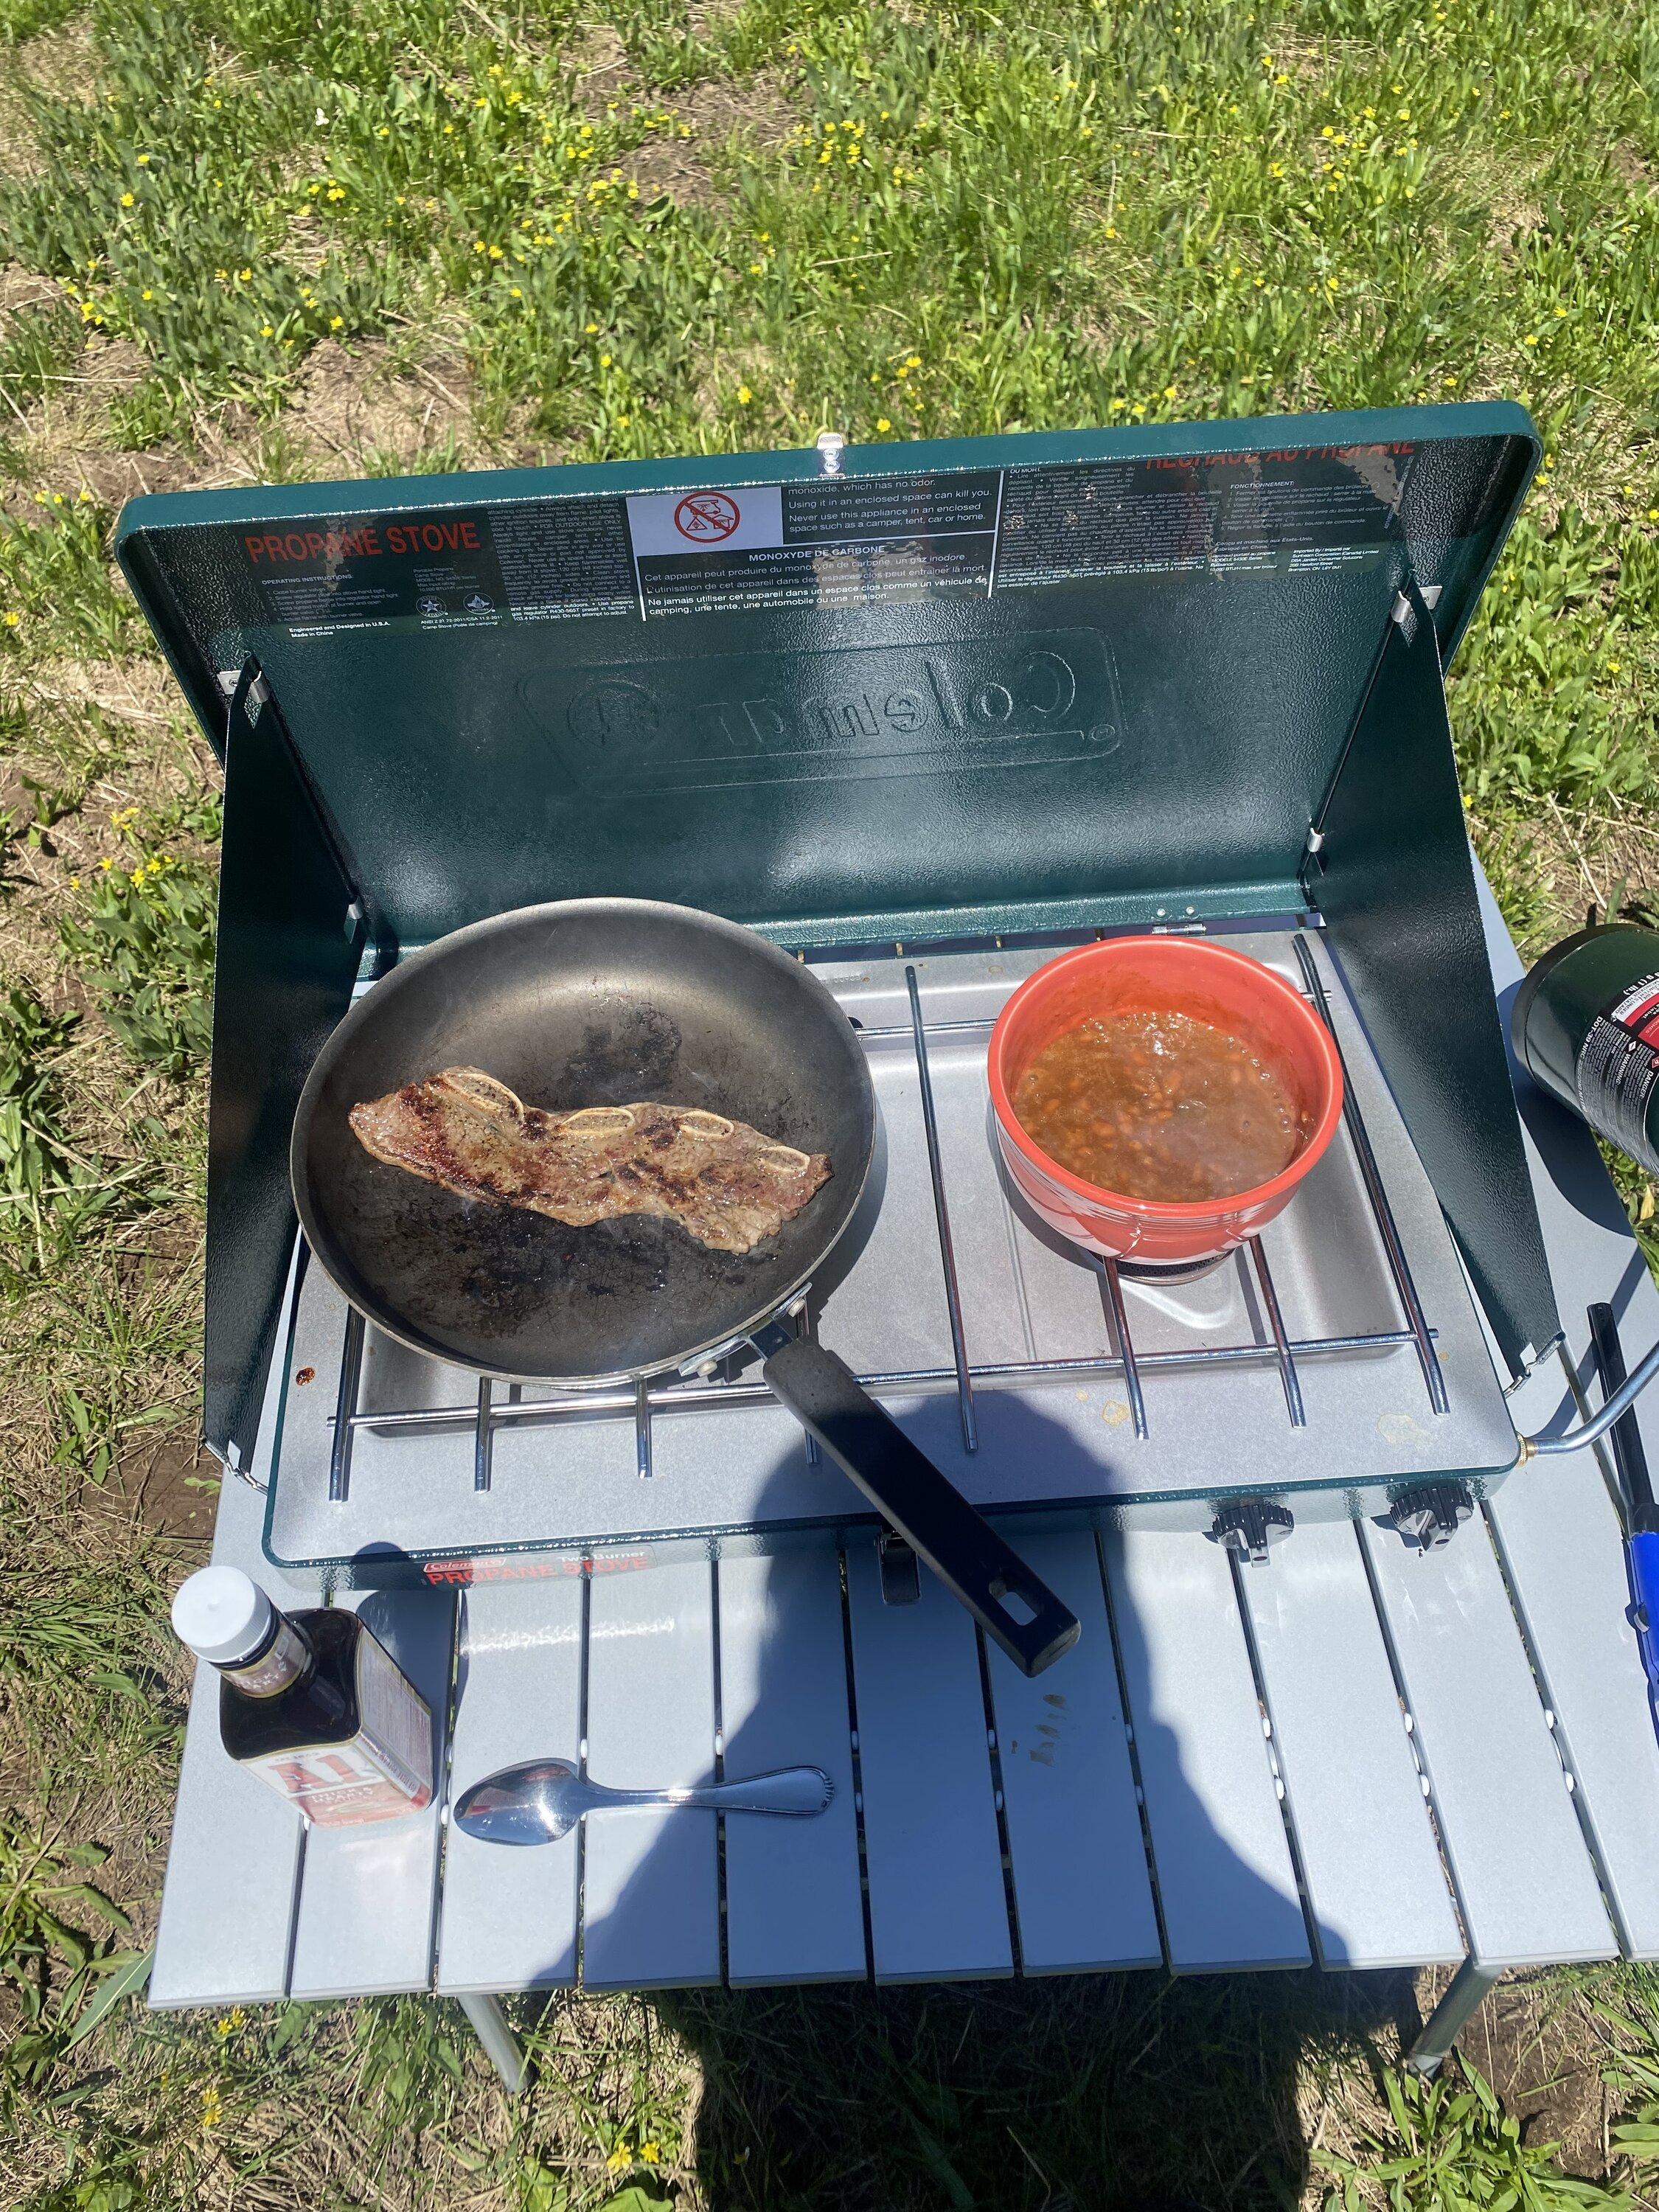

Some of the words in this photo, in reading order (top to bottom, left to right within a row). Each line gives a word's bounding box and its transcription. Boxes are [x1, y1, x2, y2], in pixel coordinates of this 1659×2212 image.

[789, 484, 839, 494] monoxide,
[844, 482, 872, 491] which
[875, 481, 892, 490] has
[911, 479, 936, 487] odor.
[1231, 481, 1294, 489] FONCTIONNEMENT
[789, 500, 816, 509] Using
[829, 498, 836, 506] in
[855, 494, 899, 504] enclosed
[902, 493, 931, 503] space
[956, 490, 968, 498] kill
[972, 490, 992, 498] you.
[790, 514, 818, 522] Never
[861, 509, 908, 519] appliance
[936, 503, 981, 512] enclosed
[790, 523, 817, 532] space
[820, 520, 841, 528] such
[866, 518, 902, 527] camper,
[905, 515, 925, 525] tent,
[957, 513, 985, 521] home.
[245, 526, 382, 563] PROPANE
[386, 522, 481, 553] STOVE
[749, 550, 813, 561] MONOXYDE
[832, 546, 885, 556] CARBONE
[645, 573, 661, 581] Cet
[664, 570, 701, 581] appareil
[704, 568, 724, 579] peut
[728, 566, 766, 577] produire
[770, 565, 781, 573] du
[837, 560, 848, 568] de
[849, 559, 889, 568] carbone,
[930, 554, 967, 562] inodore.
[302, 574, 352, 582] INSTRUCTIONS
[720, 580, 733, 588] cet
[737, 577, 773, 589] appareil
[802, 575, 820, 583] des
[884, 569, 905, 580] peut
[648, 597, 661, 605] Ne
[664, 594, 693, 606] jamais
[696, 593, 726, 602] utiliser
[729, 591, 743, 599] cet
[746, 588, 782, 600] appareil
[785, 588, 807, 596] dans
[824, 585, 860, 594] espace
[861, 582, 880, 591] clos
[883, 581, 918, 589] comme
[934, 577, 972, 586] véhicule
[650, 605, 691, 615] camping,
[714, 602, 740, 611] tente,
[763, 597, 813, 607] automobile
[853, 592, 888, 600] maison.
[559, 1553, 590, 1564] Two
[592, 1549, 646, 1561] Burner
[426, 1564, 557, 1586] PROPANE
[562, 1557, 650, 1574] STOVE
